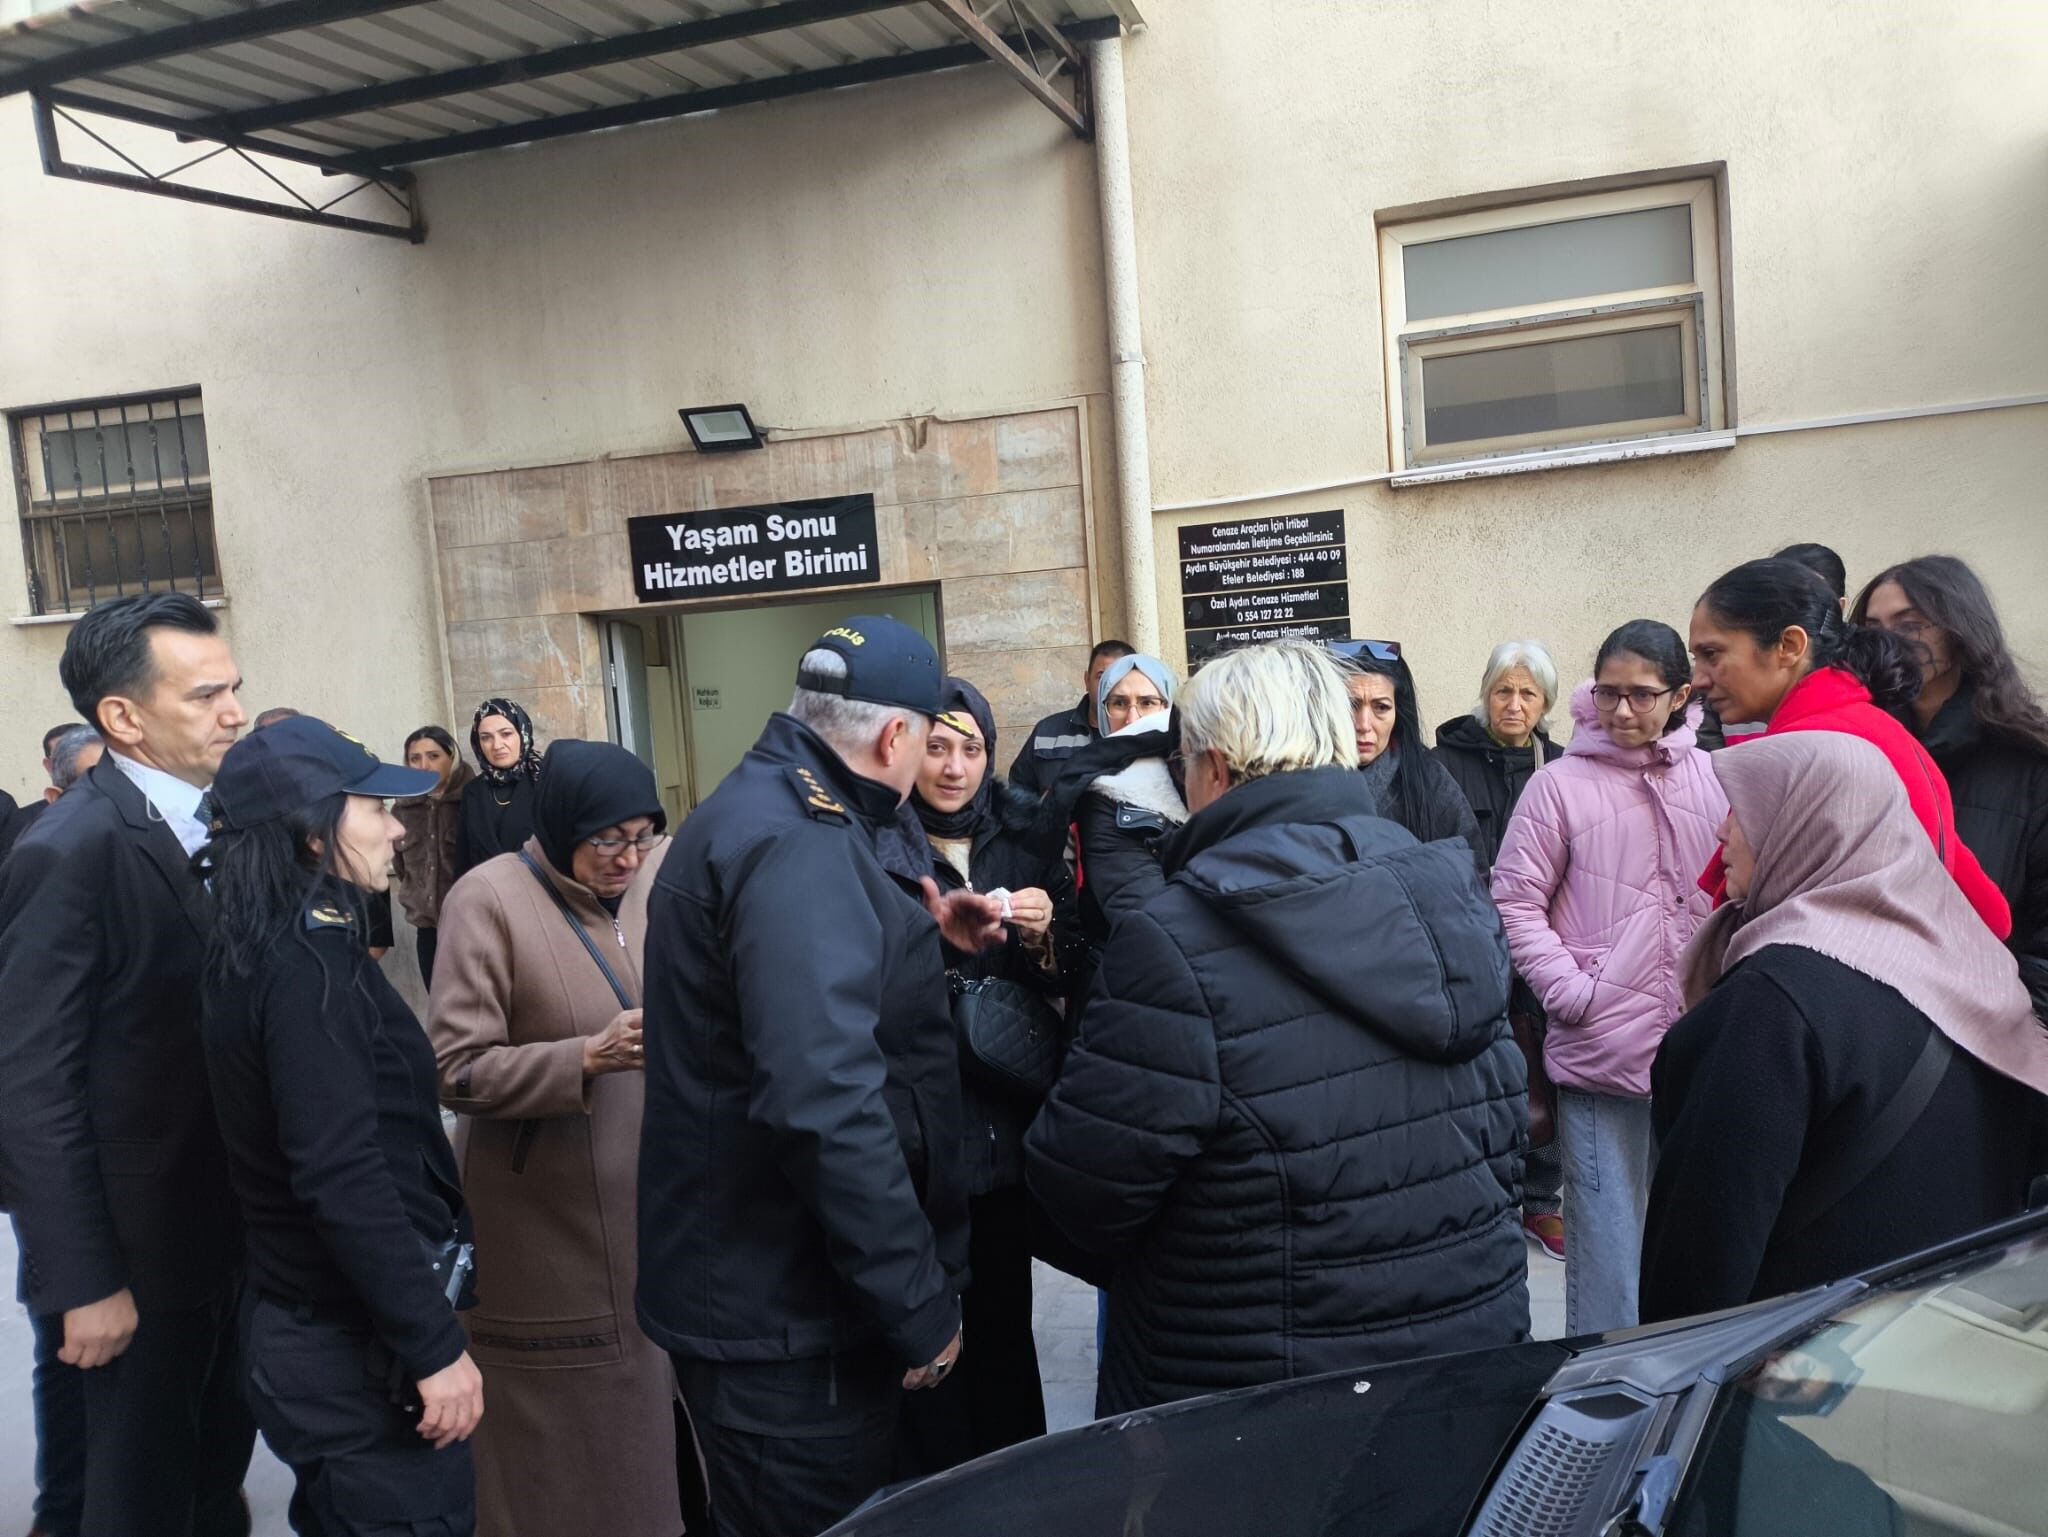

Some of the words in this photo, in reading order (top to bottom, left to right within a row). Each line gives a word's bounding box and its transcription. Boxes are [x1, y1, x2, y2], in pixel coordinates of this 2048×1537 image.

[665, 523, 758, 554] Yaşam
[766, 513, 837, 542] Sonu
[1212, 527, 1239, 537] Cenaze
[1240, 522, 1269, 535] Araçları
[1270, 518, 1284, 533] İçin
[1285, 516, 1309, 530] İrtibat
[1190, 539, 1250, 555] Numaralarından
[1251, 535, 1283, 550] İletişime
[1284, 530, 1334, 546] Geçebilirsiniz
[643, 555, 777, 590] Hizmetler
[784, 544, 868, 577] Birimi
[1185, 562, 1207, 576] Aydın
[1208, 558, 1250, 573] Büyükşehir
[1252, 553, 1292, 568] Belediyesi
[1298, 552, 1315, 563] 444
[1316, 550, 1328, 561] 40
[1330, 549, 1341, 560] 09
[1222, 573, 1245, 585] Efeler
[1246, 568, 1286, 583] Belediyesi
[1291, 568, 1305, 579] 188
[1210, 596, 1227, 609] Özel
[1229, 596, 1250, 610] Aydın
[1251, 595, 1279, 606] Cenaze
[1280, 589, 1320, 603] Hizmetleri
[1237, 611, 1243, 622] 0
[1244, 610, 1259, 622] 554
[1260, 609, 1272, 620] 127
[1273, 608, 1283, 619] 22
[1284, 607, 1294, 618] 22
[1251, 629, 1279, 639] Cenaze
